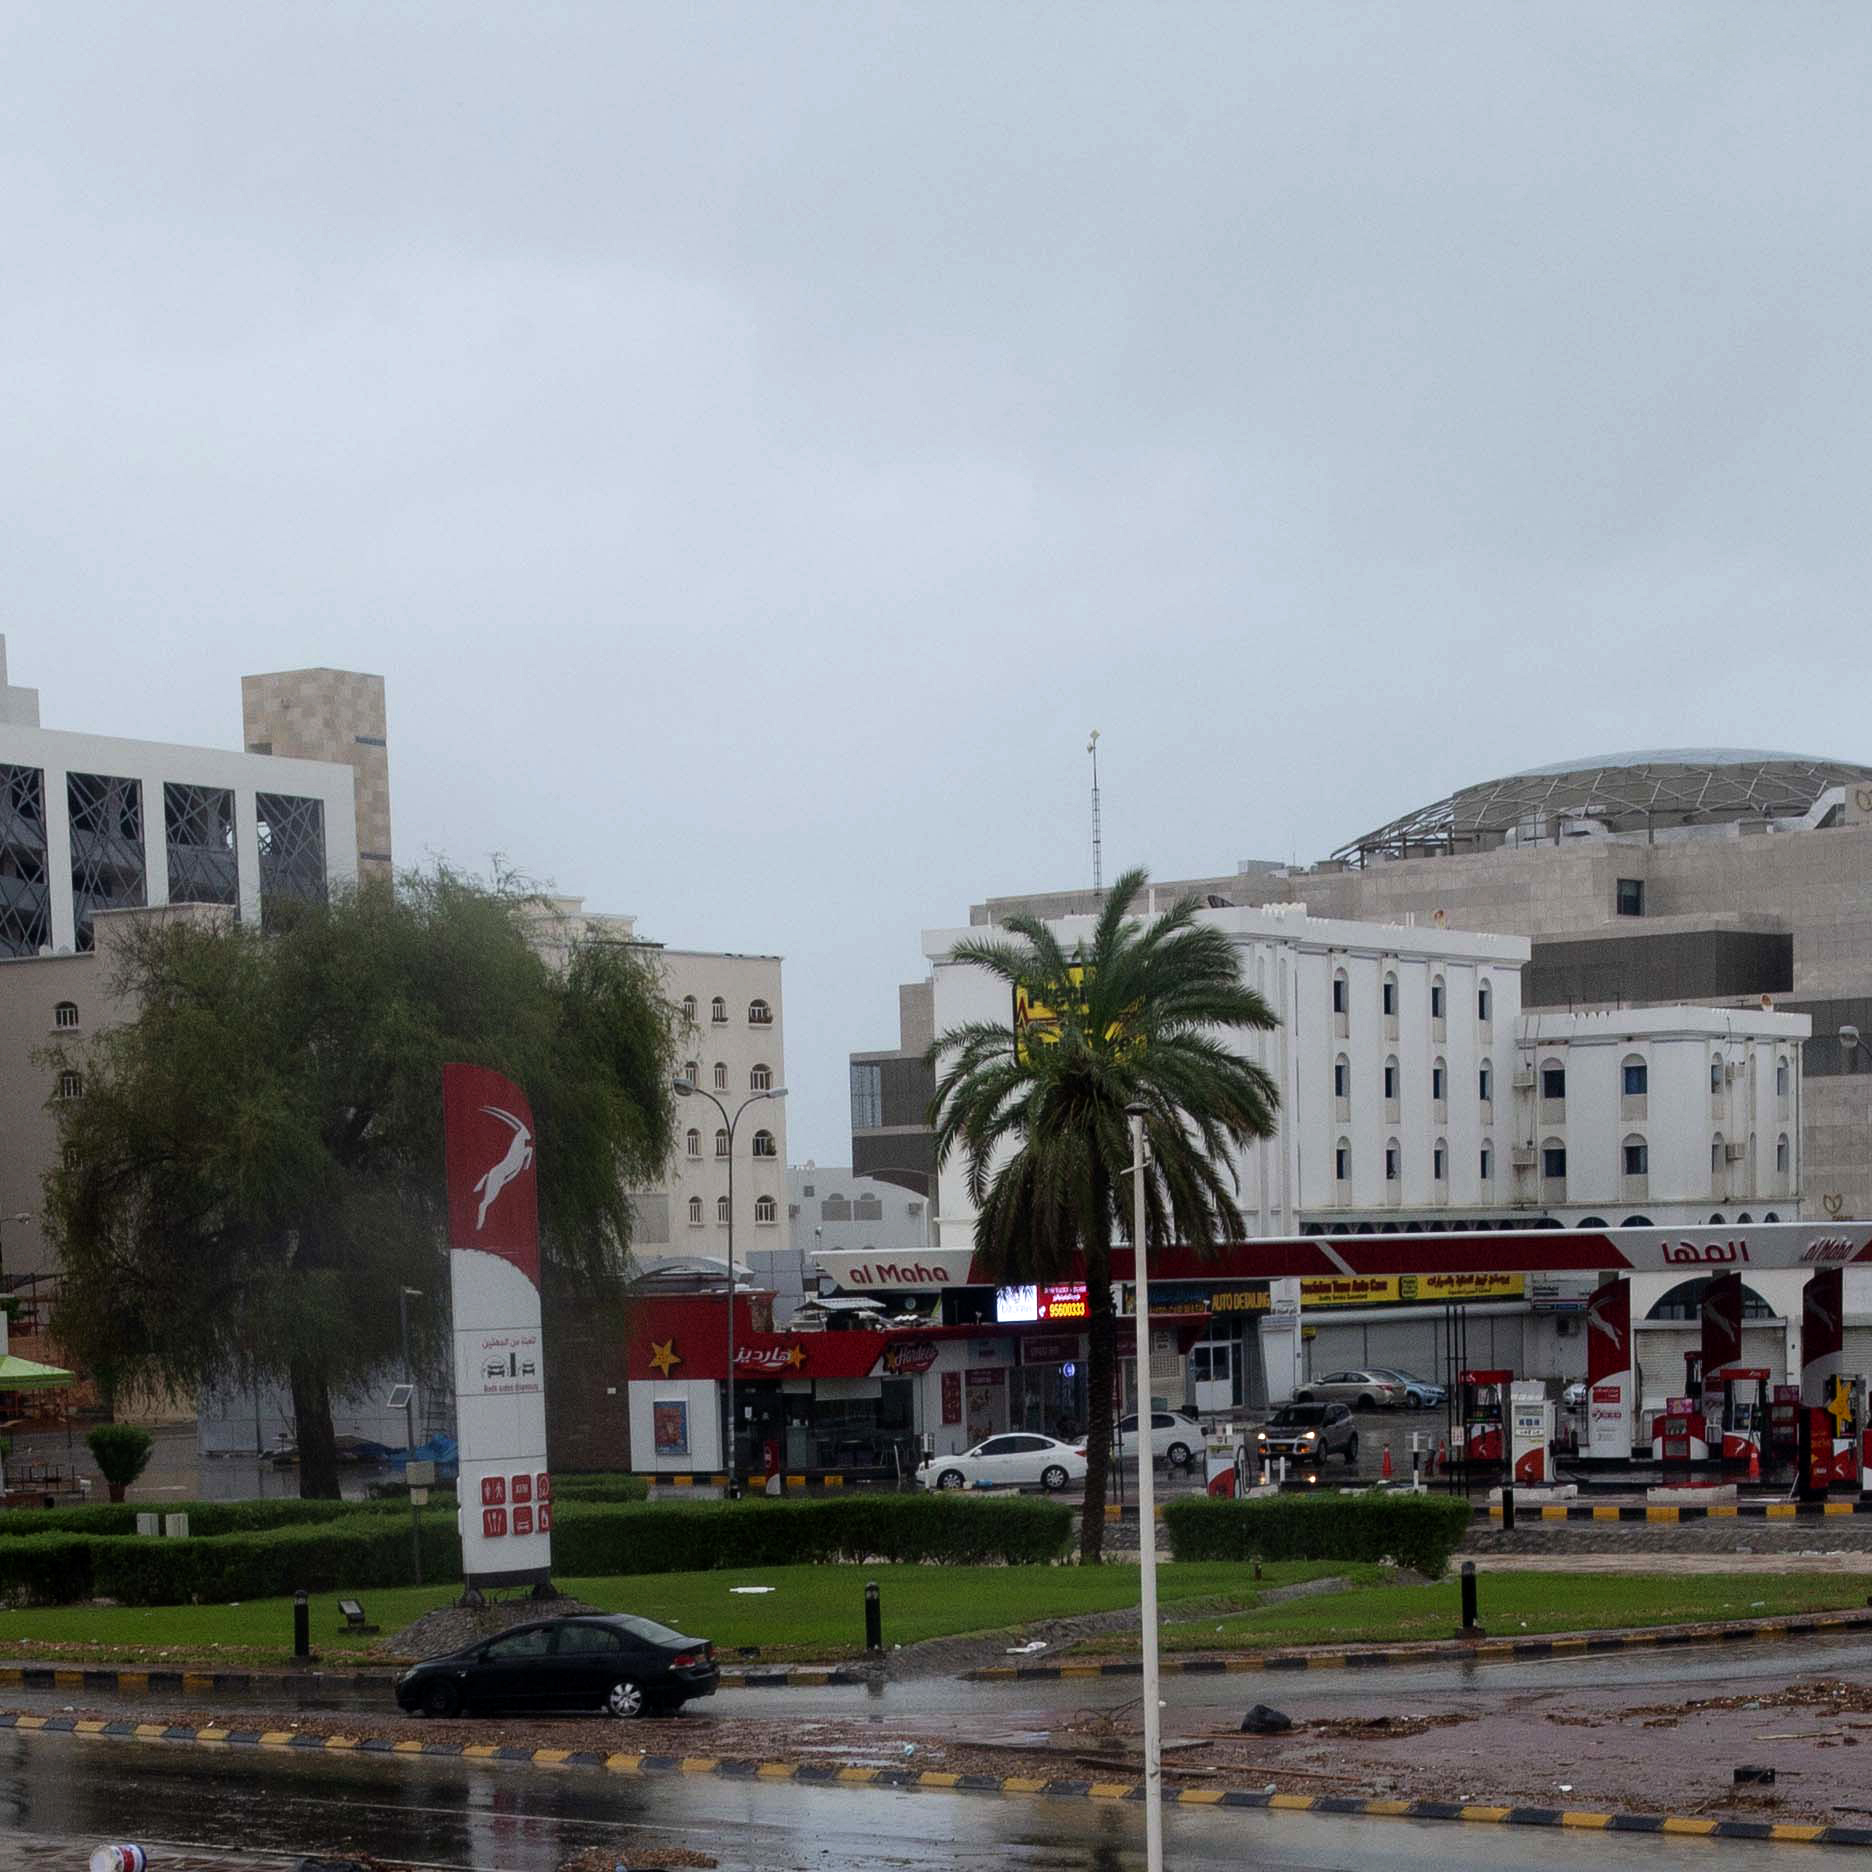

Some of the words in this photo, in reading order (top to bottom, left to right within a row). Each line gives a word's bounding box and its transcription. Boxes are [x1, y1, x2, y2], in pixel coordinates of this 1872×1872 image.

[1661, 1240, 1750, 1264] المها
[849, 1264, 873, 1284] al
[876, 1263, 950, 1284] Maha
